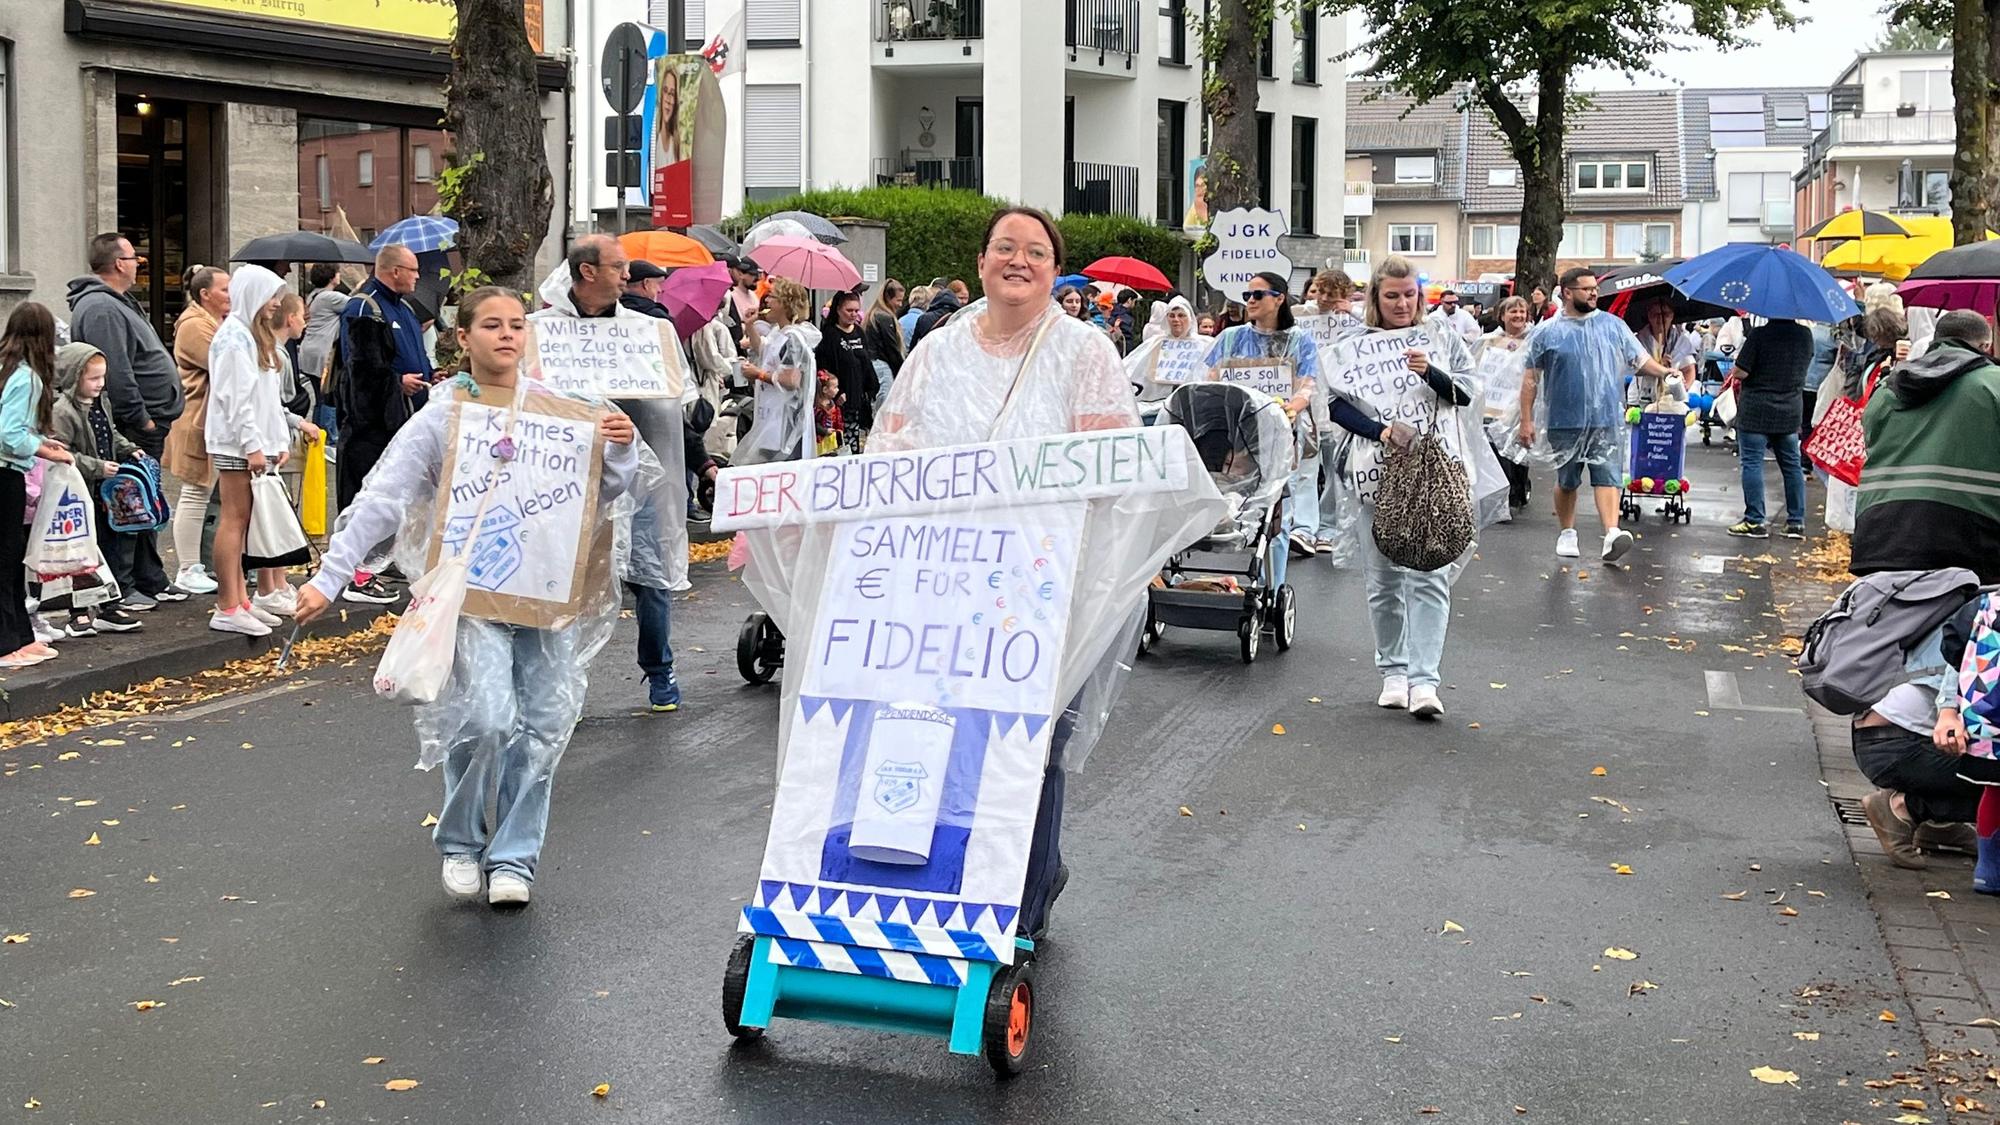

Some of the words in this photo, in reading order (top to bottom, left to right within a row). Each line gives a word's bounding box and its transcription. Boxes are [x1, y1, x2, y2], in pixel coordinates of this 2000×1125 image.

[1228, 224, 1270, 237] JGK
[1221, 249, 1276, 260] FIDELIO
[1220, 272, 1256, 282] KIND
[545, 319, 597, 336] Willst
[608, 323, 629, 338] du
[539, 339, 572, 354] den
[579, 338, 617, 357] Zug
[623, 341, 661, 355] auch
[1352, 332, 1430, 359] Kirmes
[1222, 368, 1251, 381] Alles
[1258, 368, 1280, 380] soll
[486, 409, 574, 442] Krmes
[727, 472, 801, 518] DER
[812, 448, 999, 511] BÜRRIGER
[1009, 431, 1168, 491] WESTEN
[515, 480, 582, 518] leben
[850, 524, 1016, 563] SAMMELT
[854, 568, 890, 599] €
[915, 569, 971, 597] FÜR
[823, 618, 1040, 683] FIDELIO
